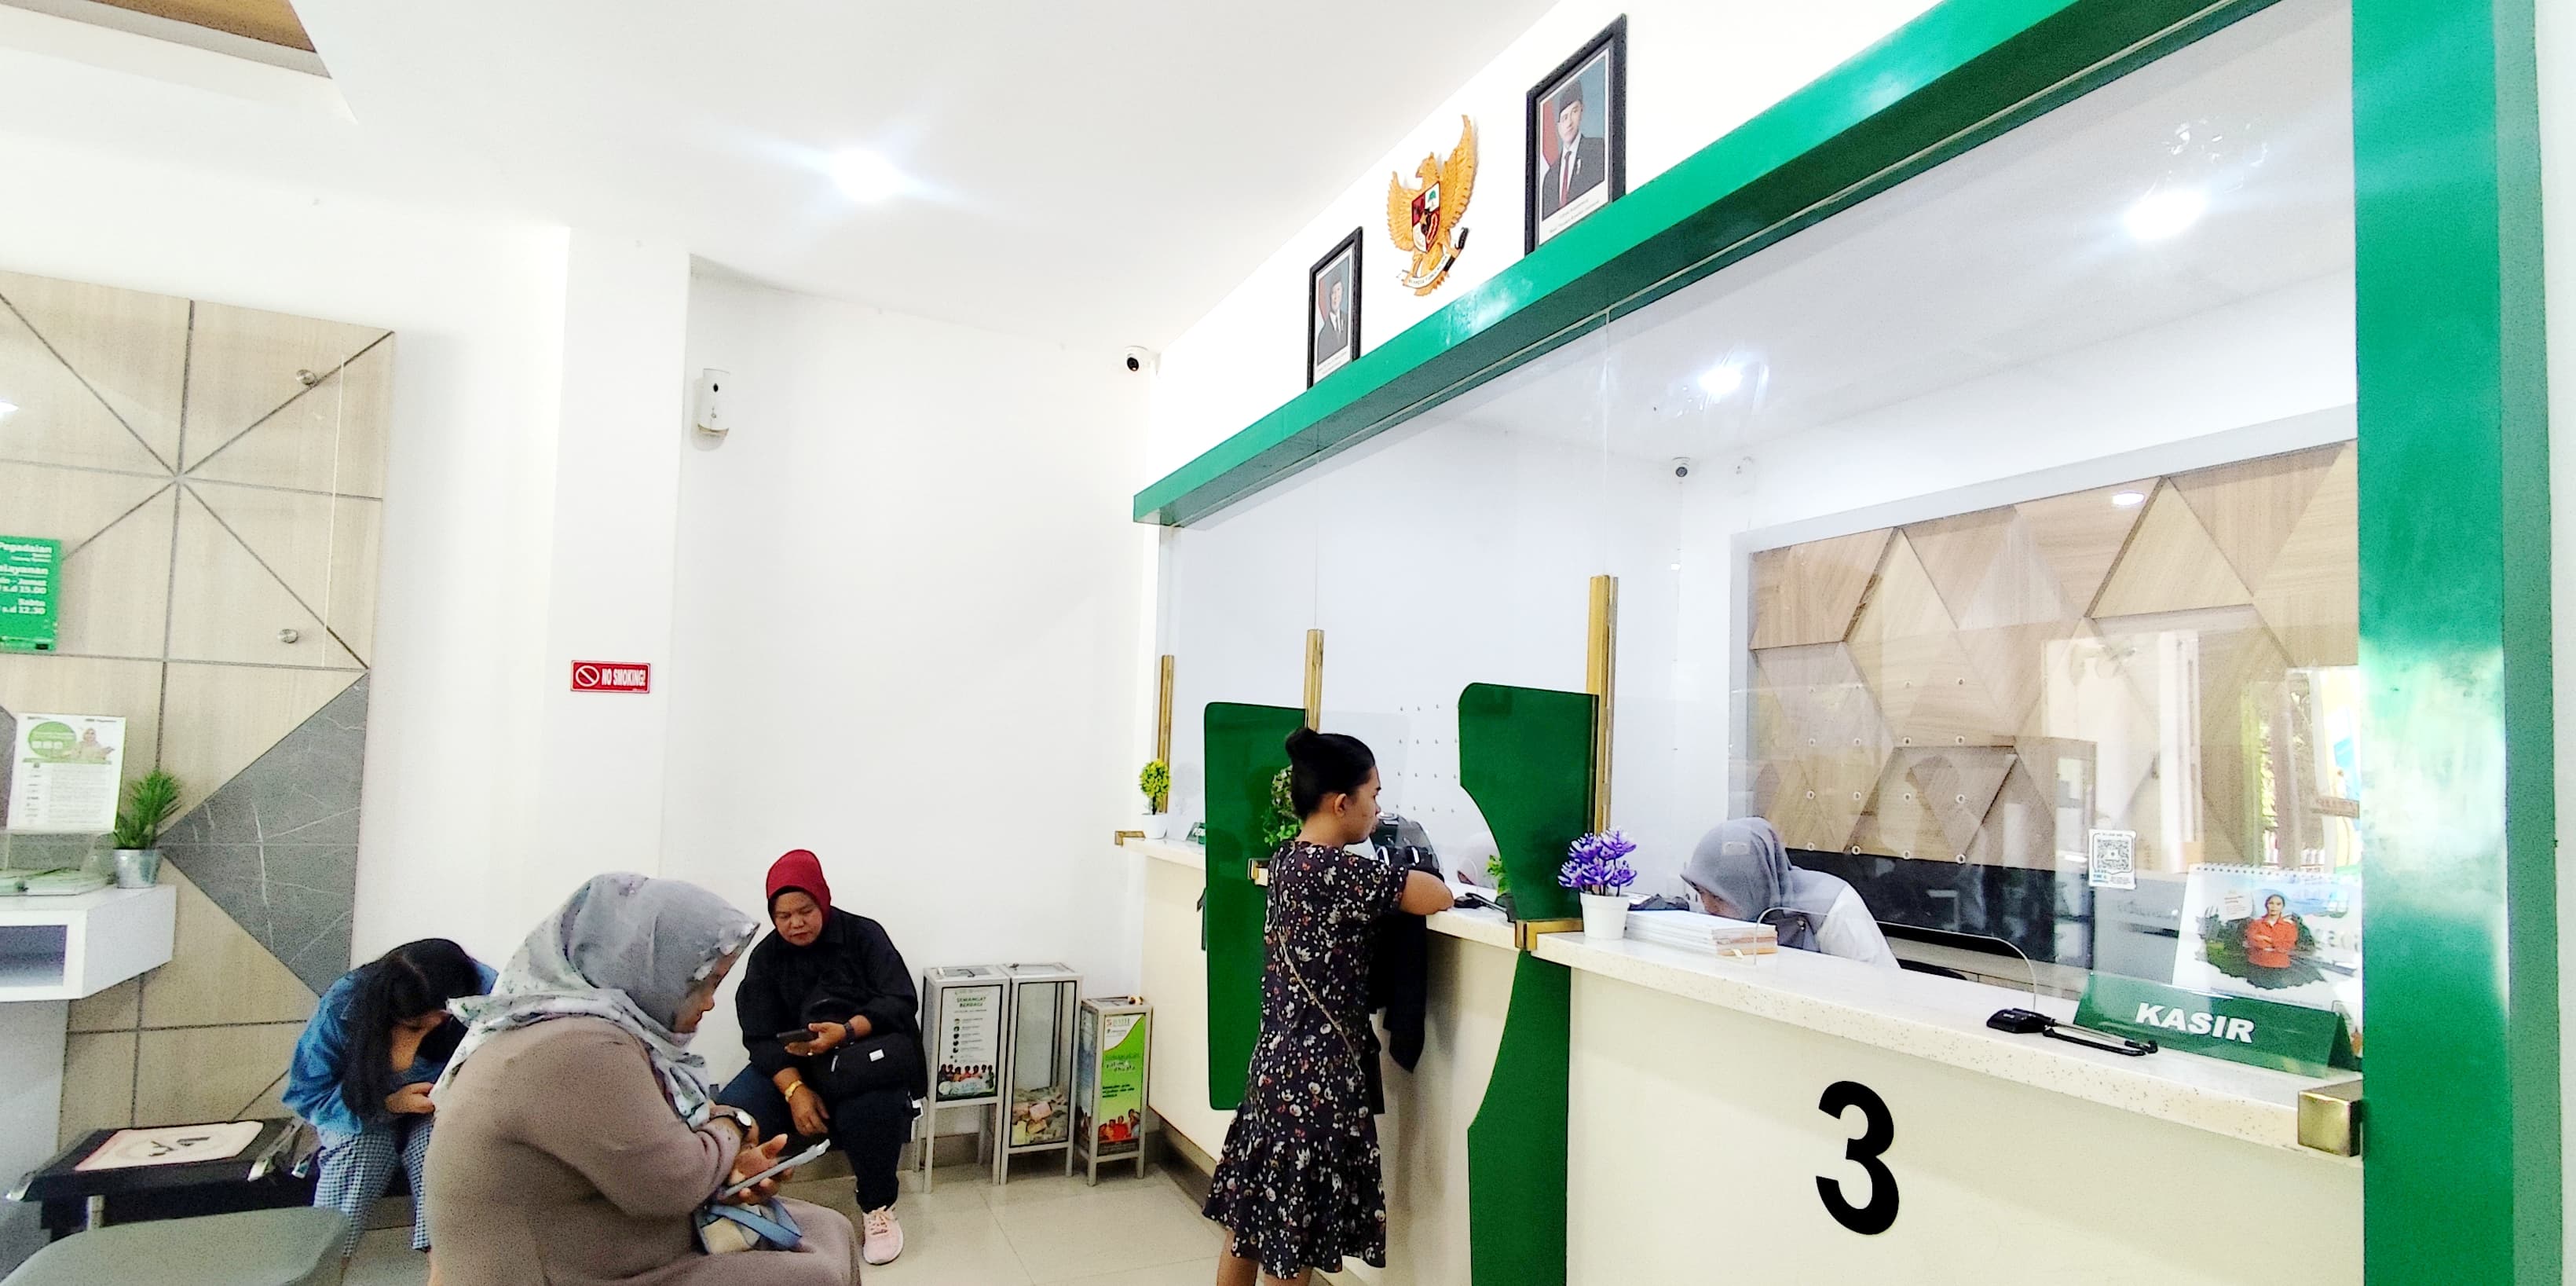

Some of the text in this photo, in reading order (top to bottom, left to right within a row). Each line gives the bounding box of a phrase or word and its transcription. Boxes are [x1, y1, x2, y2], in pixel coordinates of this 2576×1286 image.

[601, 668, 646, 687] NO SMOKING!
[2135, 1002, 2255, 1044] KASIR
[1816, 1080, 1900, 1235] 3
